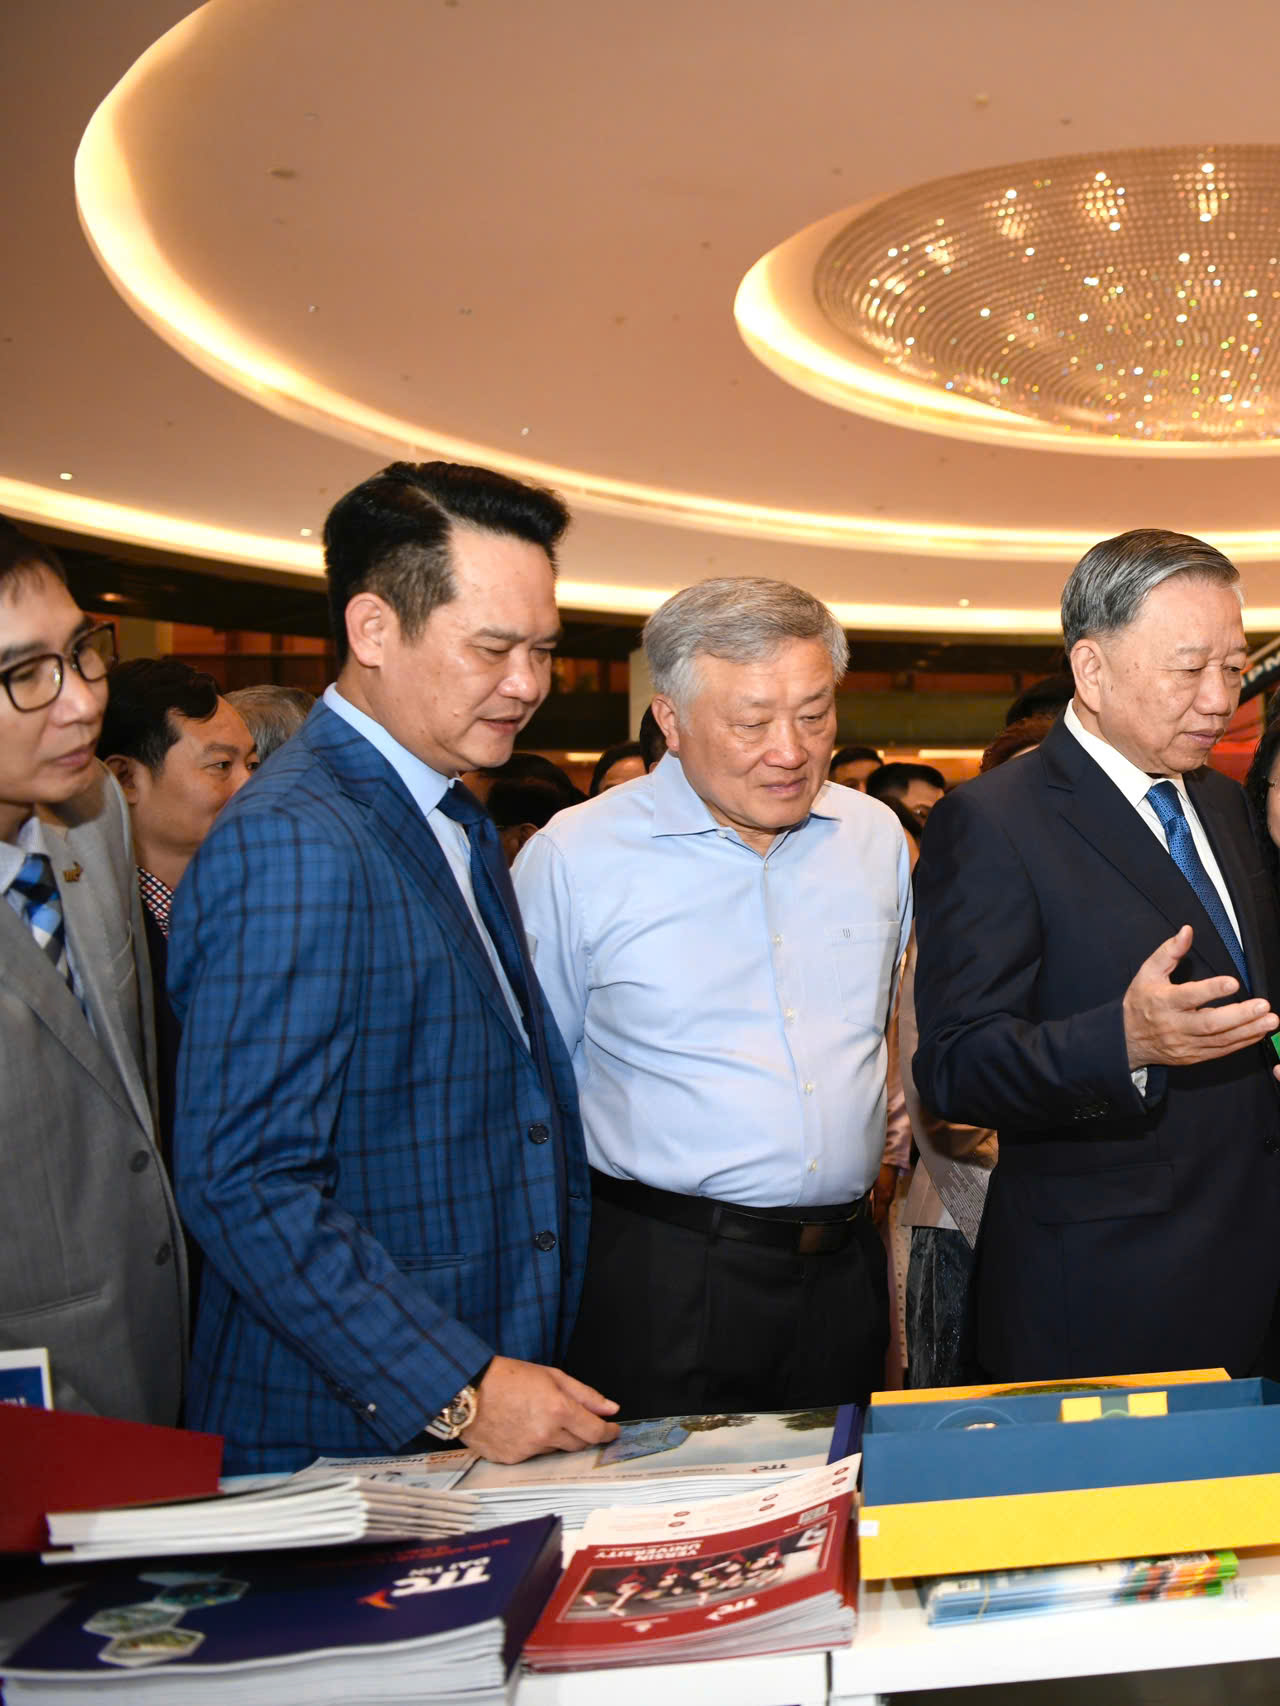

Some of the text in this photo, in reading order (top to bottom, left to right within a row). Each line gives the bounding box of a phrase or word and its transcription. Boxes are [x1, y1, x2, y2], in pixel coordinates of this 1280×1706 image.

[757, 1463, 788, 1472] TTC
[595, 1544, 702, 1558] UNIVERSITY
[634, 1550, 697, 1563] YERSIN
[391, 1565, 491, 1598] TTC
[718, 1598, 759, 1616] TTC
